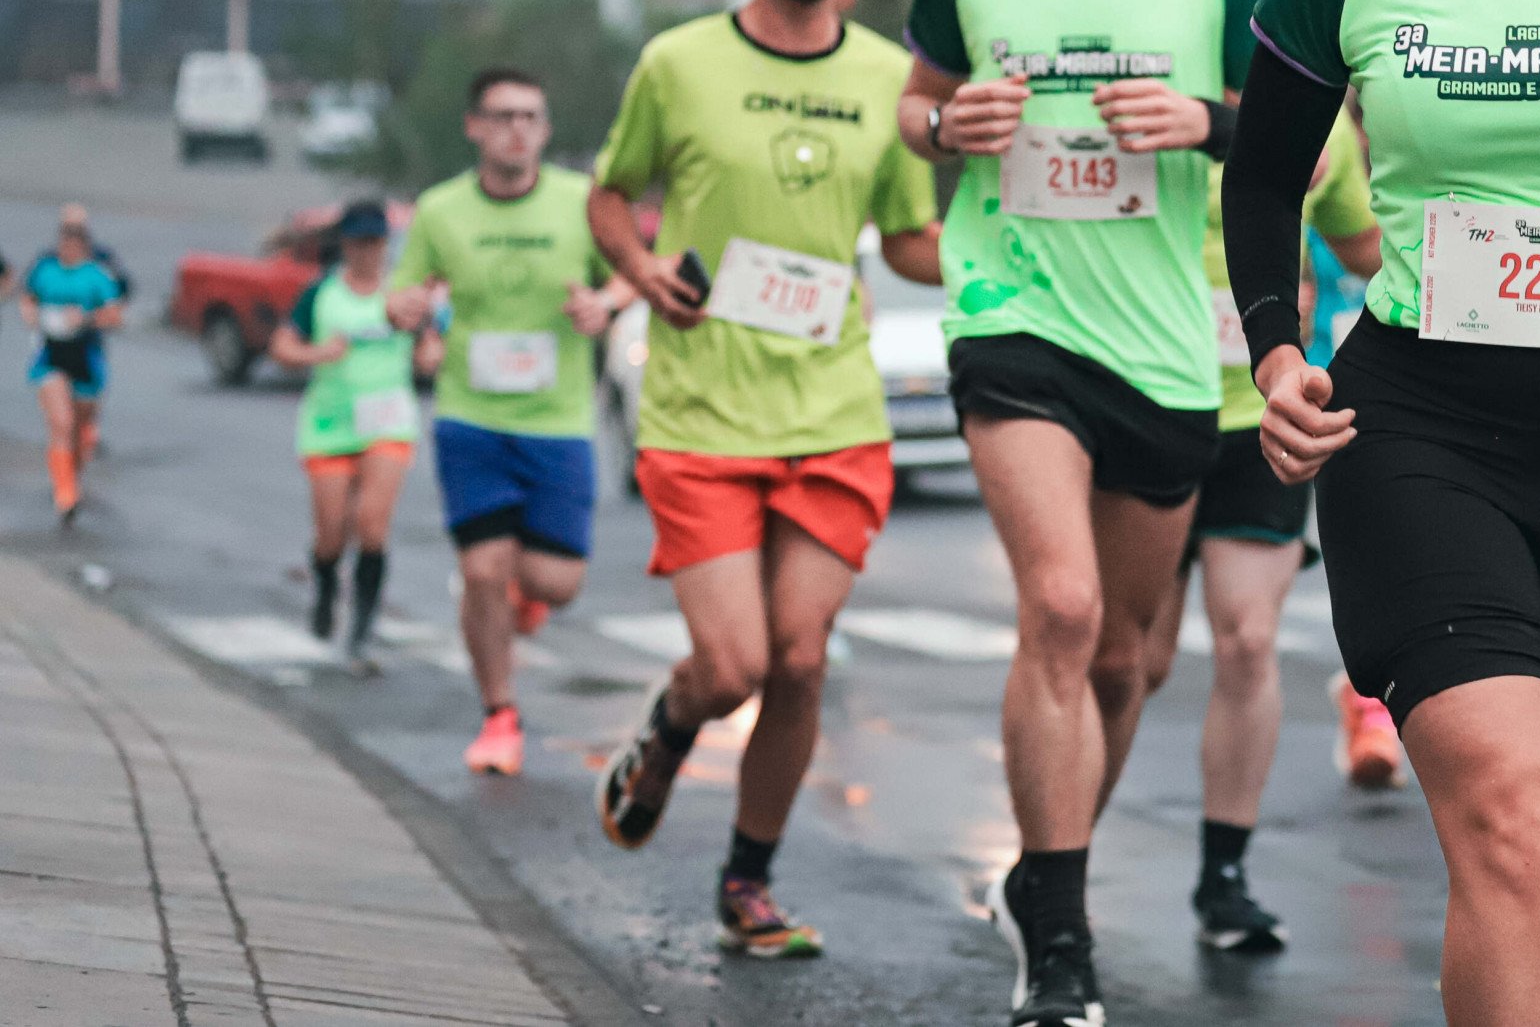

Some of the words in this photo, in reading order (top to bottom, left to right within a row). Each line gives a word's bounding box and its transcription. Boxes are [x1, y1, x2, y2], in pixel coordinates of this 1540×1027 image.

[1439, 80, 1521, 95] GRAMADO
[1526, 81, 1537, 96] E
[1048, 157, 1118, 190] 2143
[1469, 228, 1495, 243] TH2
